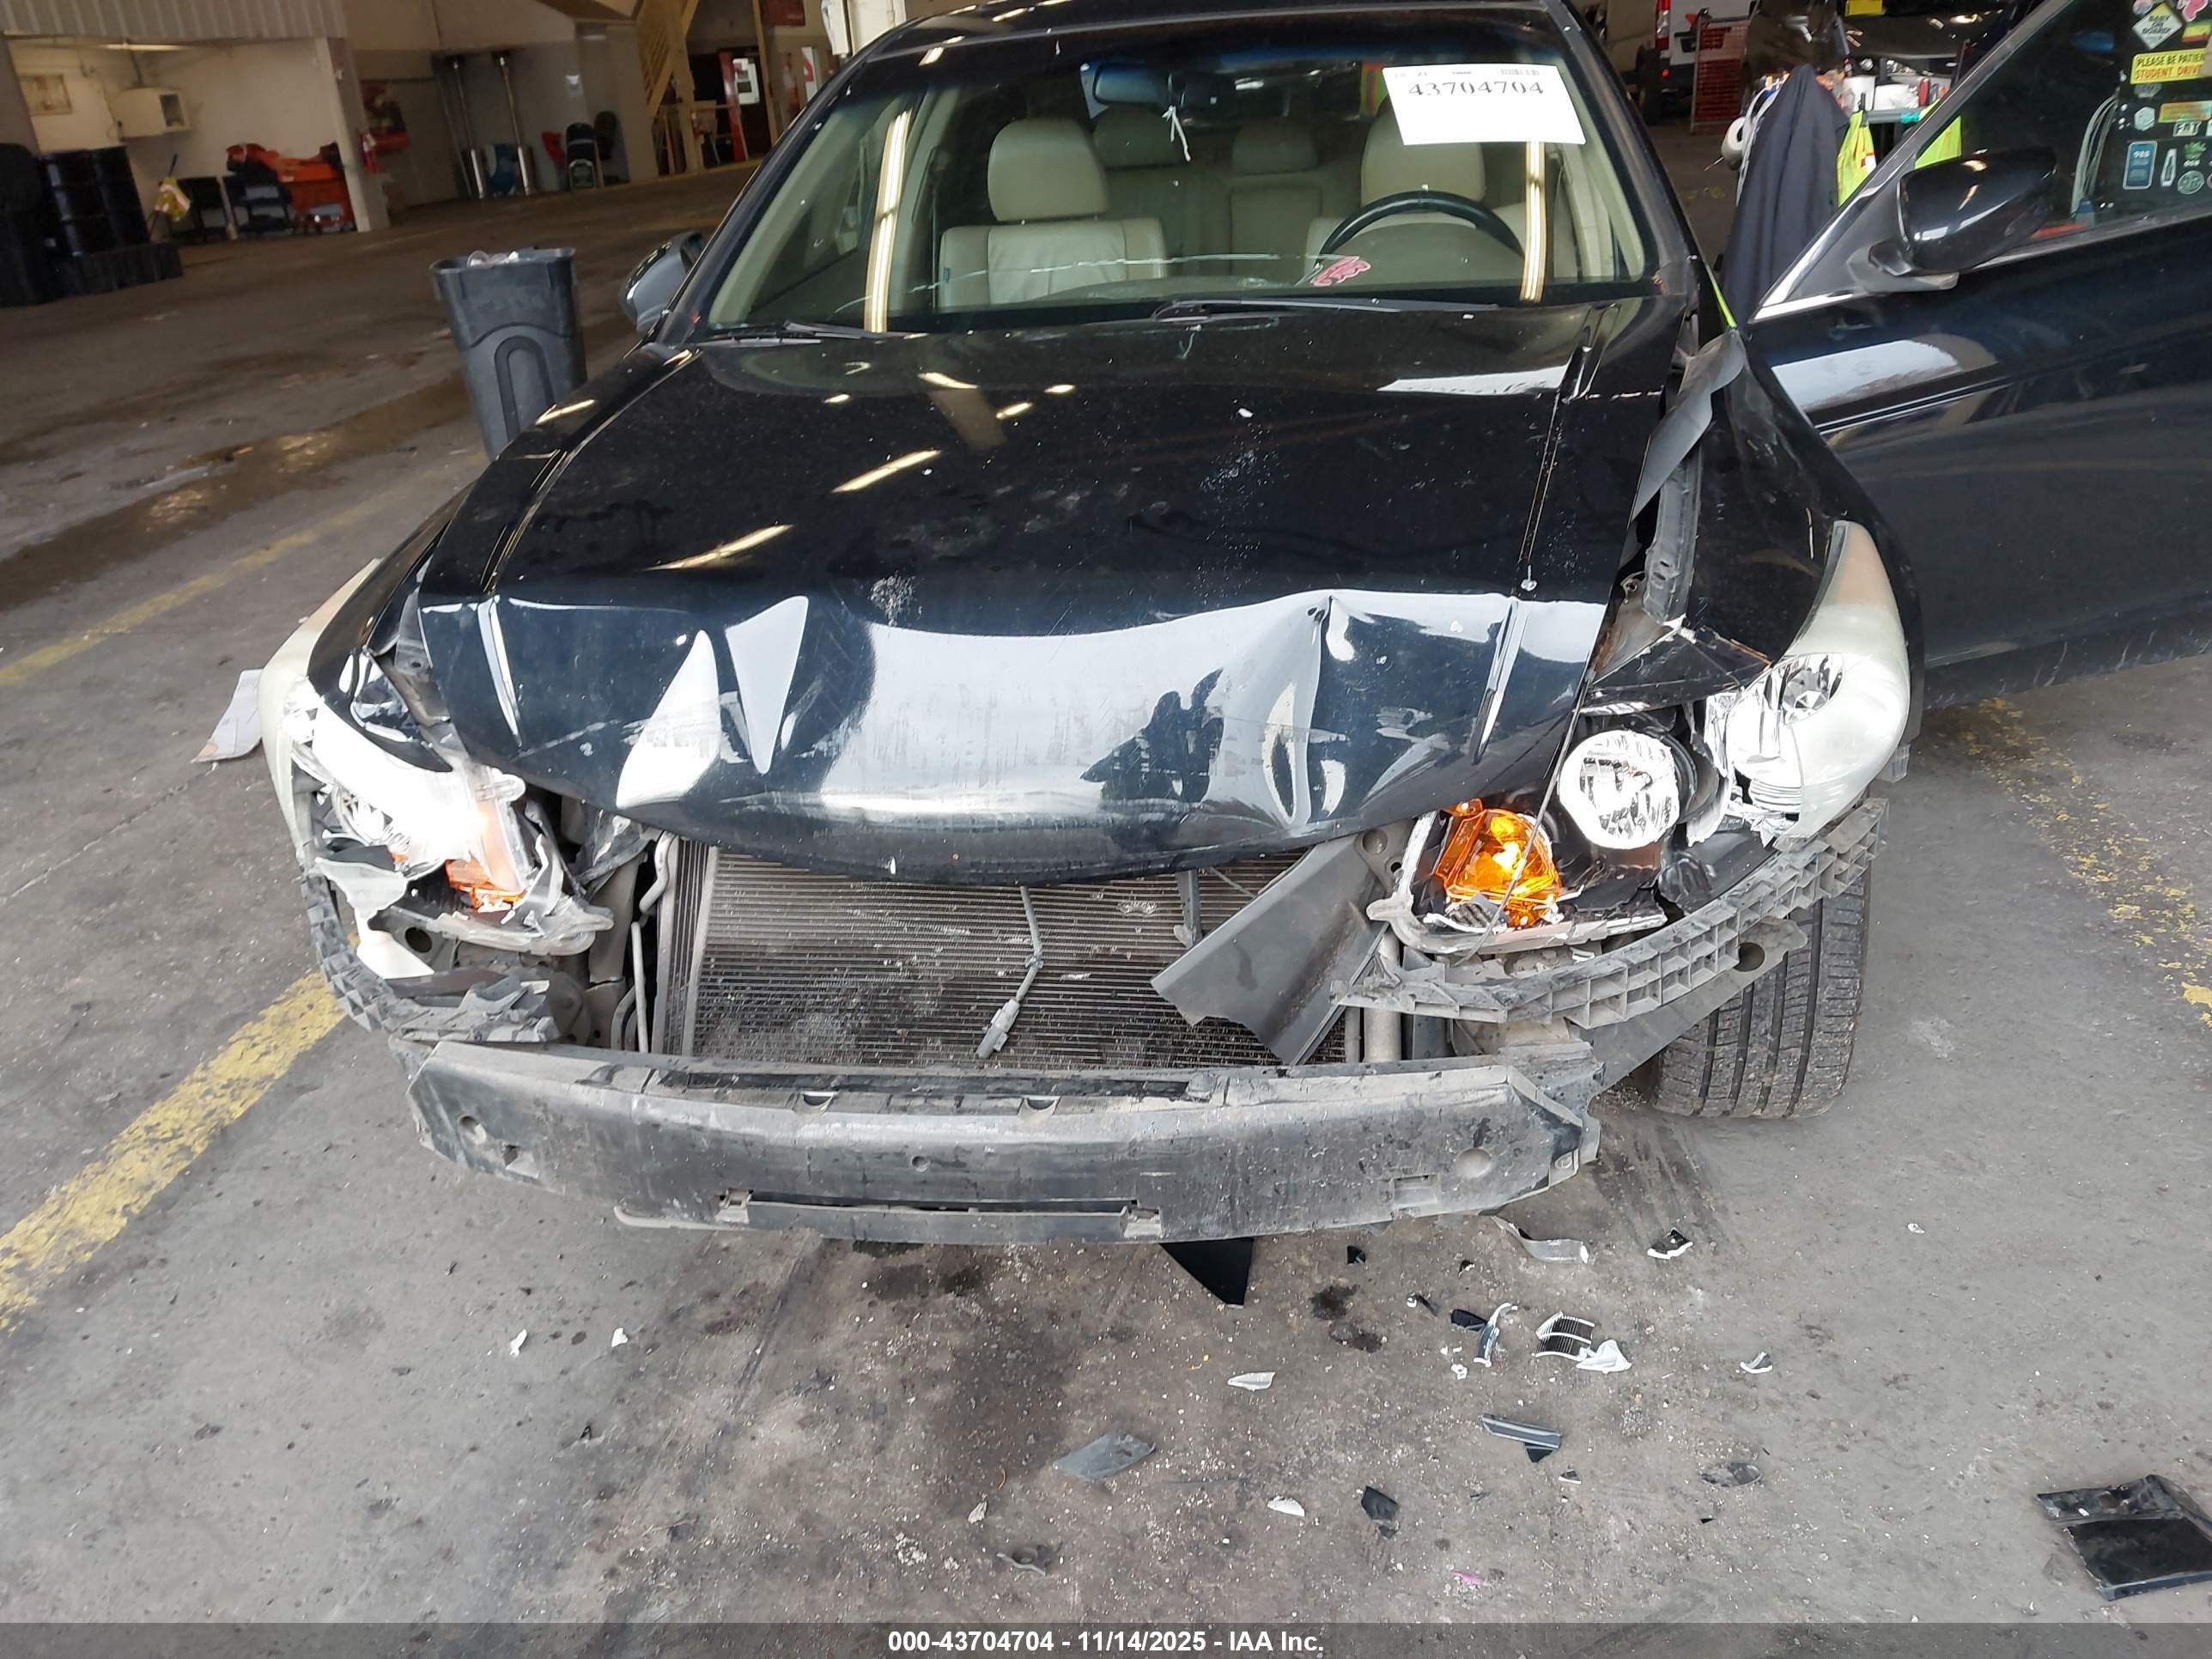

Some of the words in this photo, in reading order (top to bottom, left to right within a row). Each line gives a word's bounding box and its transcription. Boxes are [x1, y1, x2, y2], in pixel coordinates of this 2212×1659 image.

[2136, 56, 2165, 67] PLEASE
[2166, 55, 2178, 64] BE
[2178, 53, 2205, 63] PATIEN
[2136, 66, 2172, 80] STUDENT
[1409, 81, 1544, 96] 43704704
